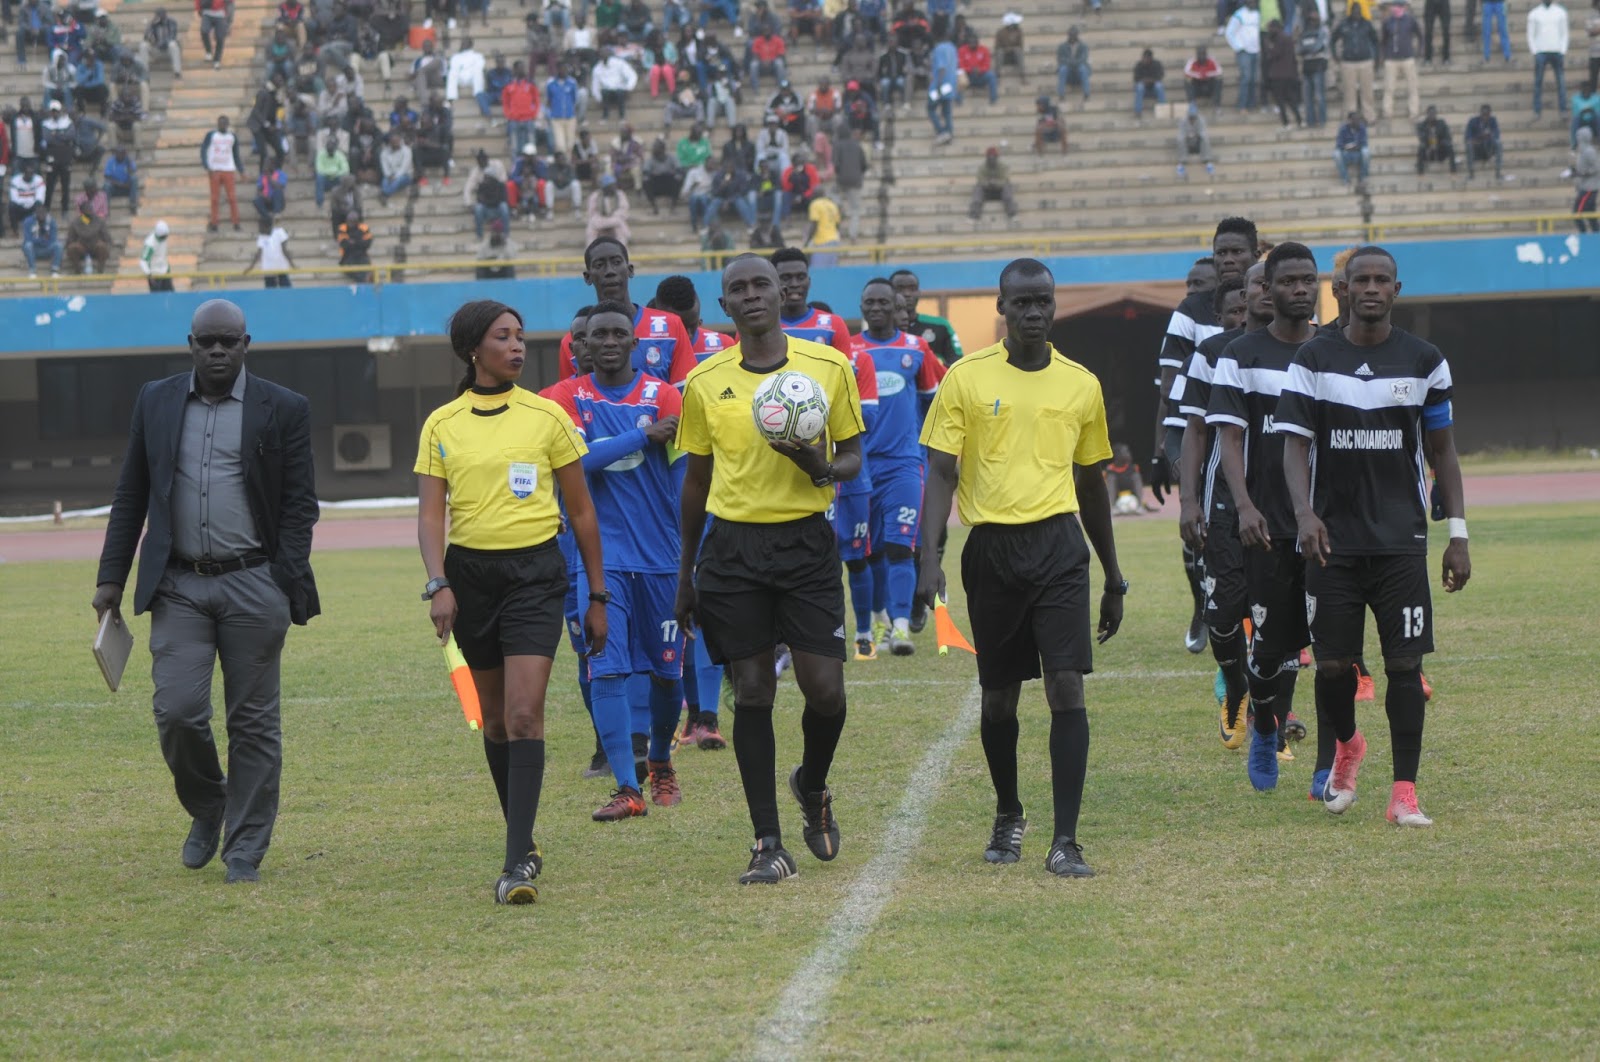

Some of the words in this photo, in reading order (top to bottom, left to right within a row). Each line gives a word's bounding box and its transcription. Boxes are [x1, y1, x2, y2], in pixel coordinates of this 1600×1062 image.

[1330, 429, 1353, 449] ASAC
[1354, 429, 1403, 450] NDIAMBOUR
[514, 477, 532, 486] FIFA
[898, 507, 917, 525] 22
[854, 522, 868, 538] 19
[660, 619, 679, 643] 17
[1402, 606, 1424, 638] 13
